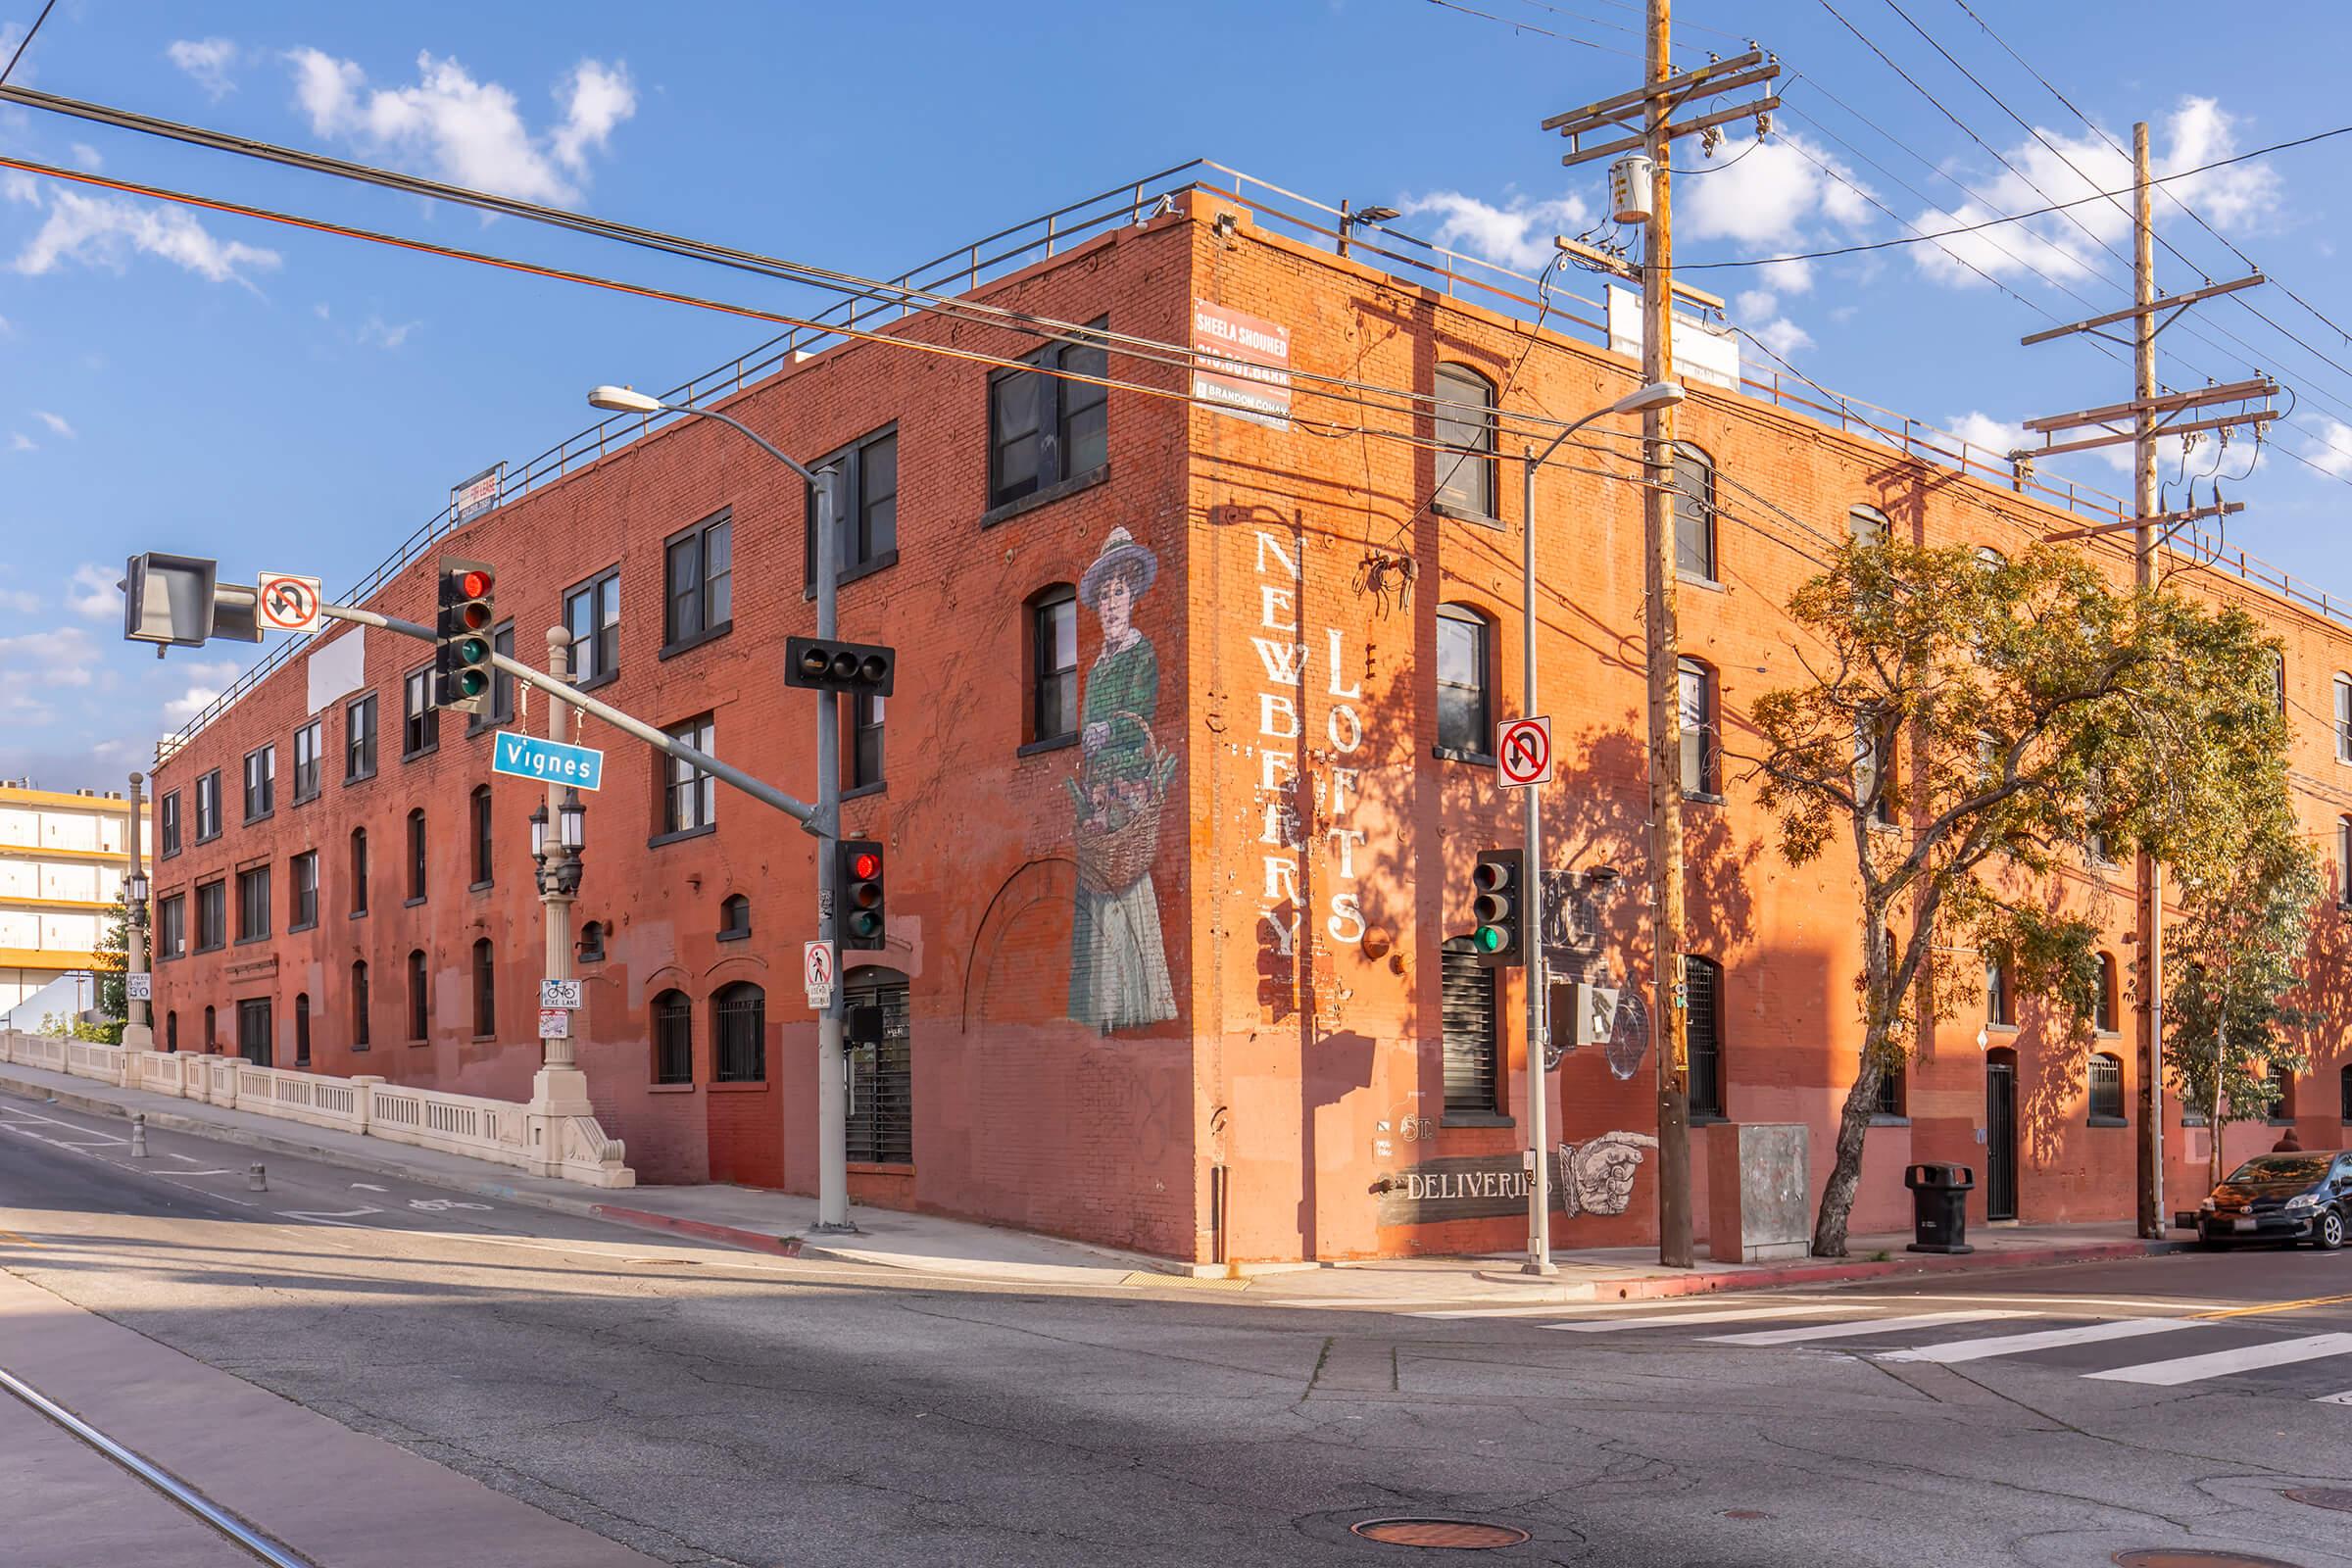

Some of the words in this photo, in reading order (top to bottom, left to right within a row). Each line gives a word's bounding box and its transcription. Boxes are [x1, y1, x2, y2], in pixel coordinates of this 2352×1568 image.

[1197, 313, 1237, 342] SHEELA
[1239, 326, 1287, 358] SHOUHED
[1208, 384, 1254, 408] BRANDON
[507, 740, 591, 779] Vignes
[1326, 628, 1367, 944] LOFTS
[1407, 1171, 1552, 1200] DELIVERI
